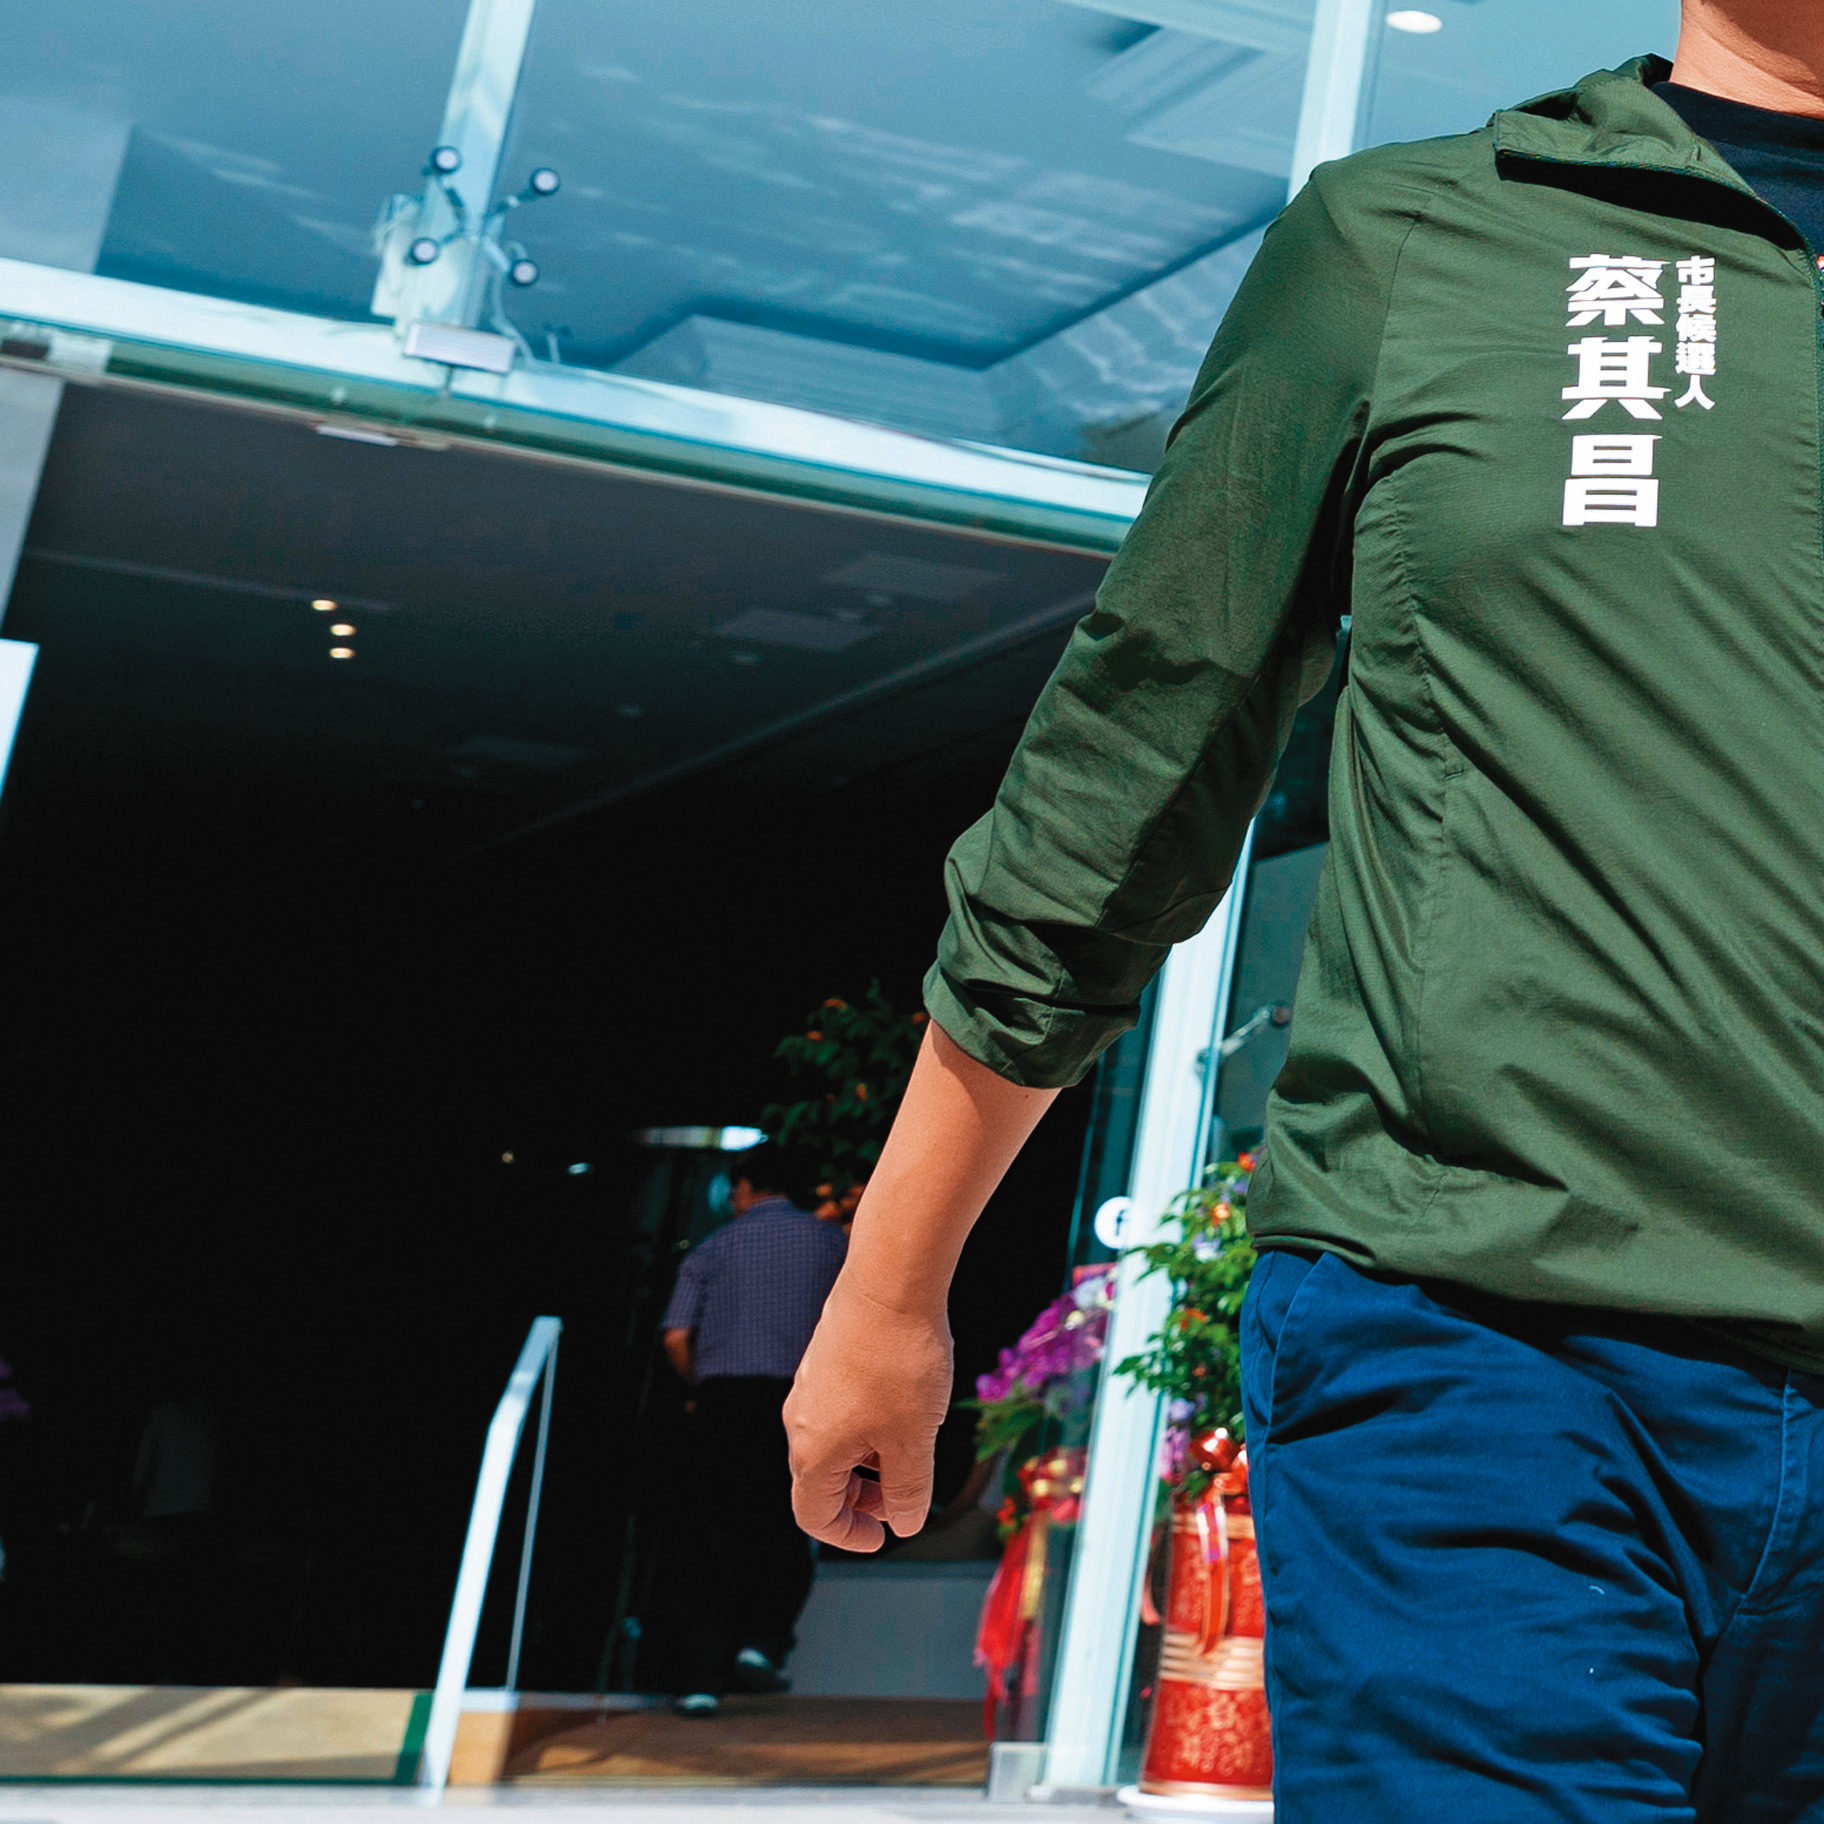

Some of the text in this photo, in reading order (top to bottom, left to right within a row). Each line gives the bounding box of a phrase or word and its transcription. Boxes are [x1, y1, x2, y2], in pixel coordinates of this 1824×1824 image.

[1561, 253, 1671, 528] 蔡其昌
[1674, 254, 1717, 410] 市長候選人
